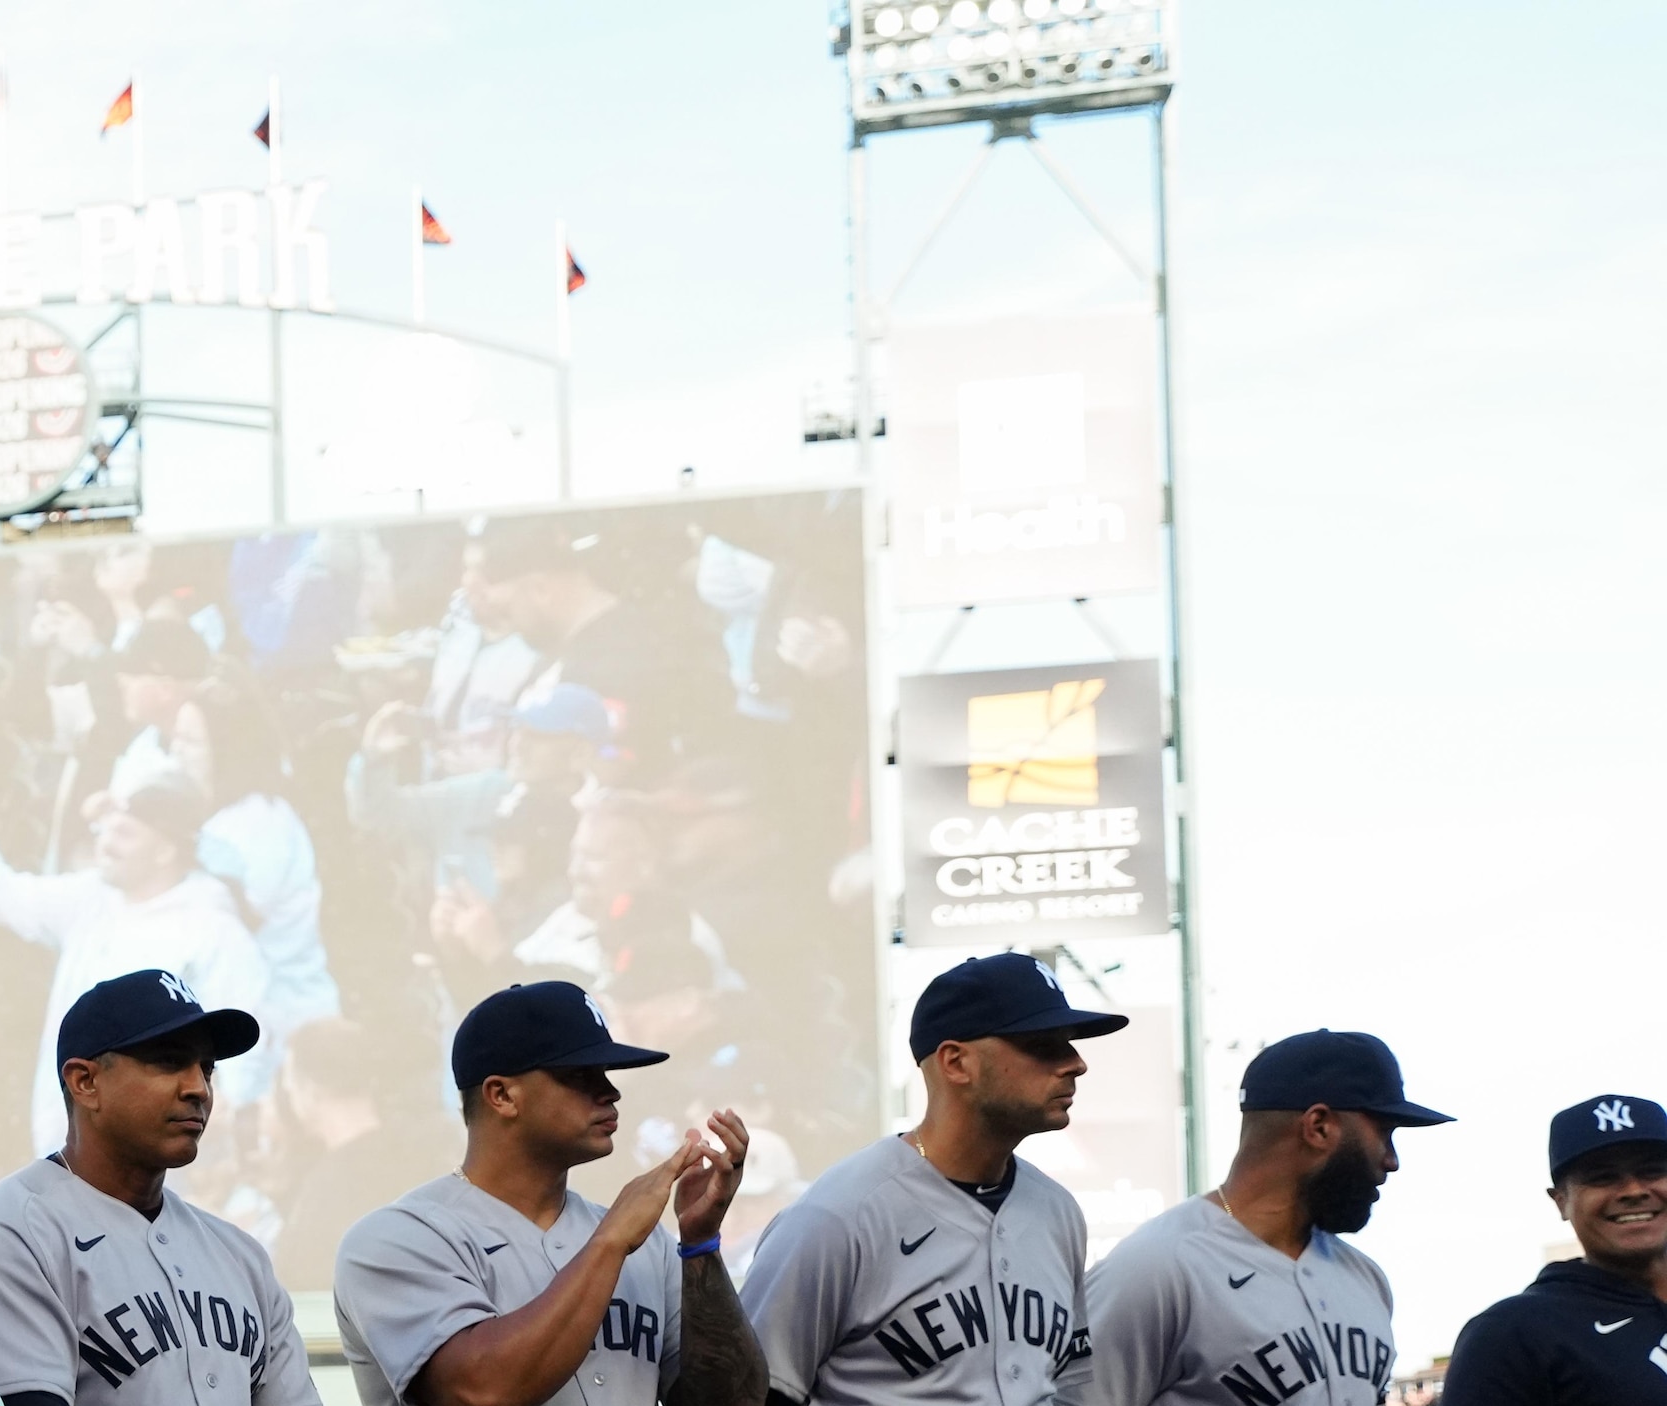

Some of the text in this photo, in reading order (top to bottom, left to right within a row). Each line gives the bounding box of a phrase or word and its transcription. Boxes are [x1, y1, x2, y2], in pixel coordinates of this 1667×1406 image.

[75, 176, 335, 313] PARK
[924, 493, 1126, 557] Health
[929, 806, 1141, 856] CACHE
[935, 847, 1137, 898] CREEK
[1592, 1098, 1635, 1132] NY
[79, 1291, 182, 1390] NEW
[874, 1285, 989, 1379] NEW
[1322, 1322, 1391, 1400] YOR
